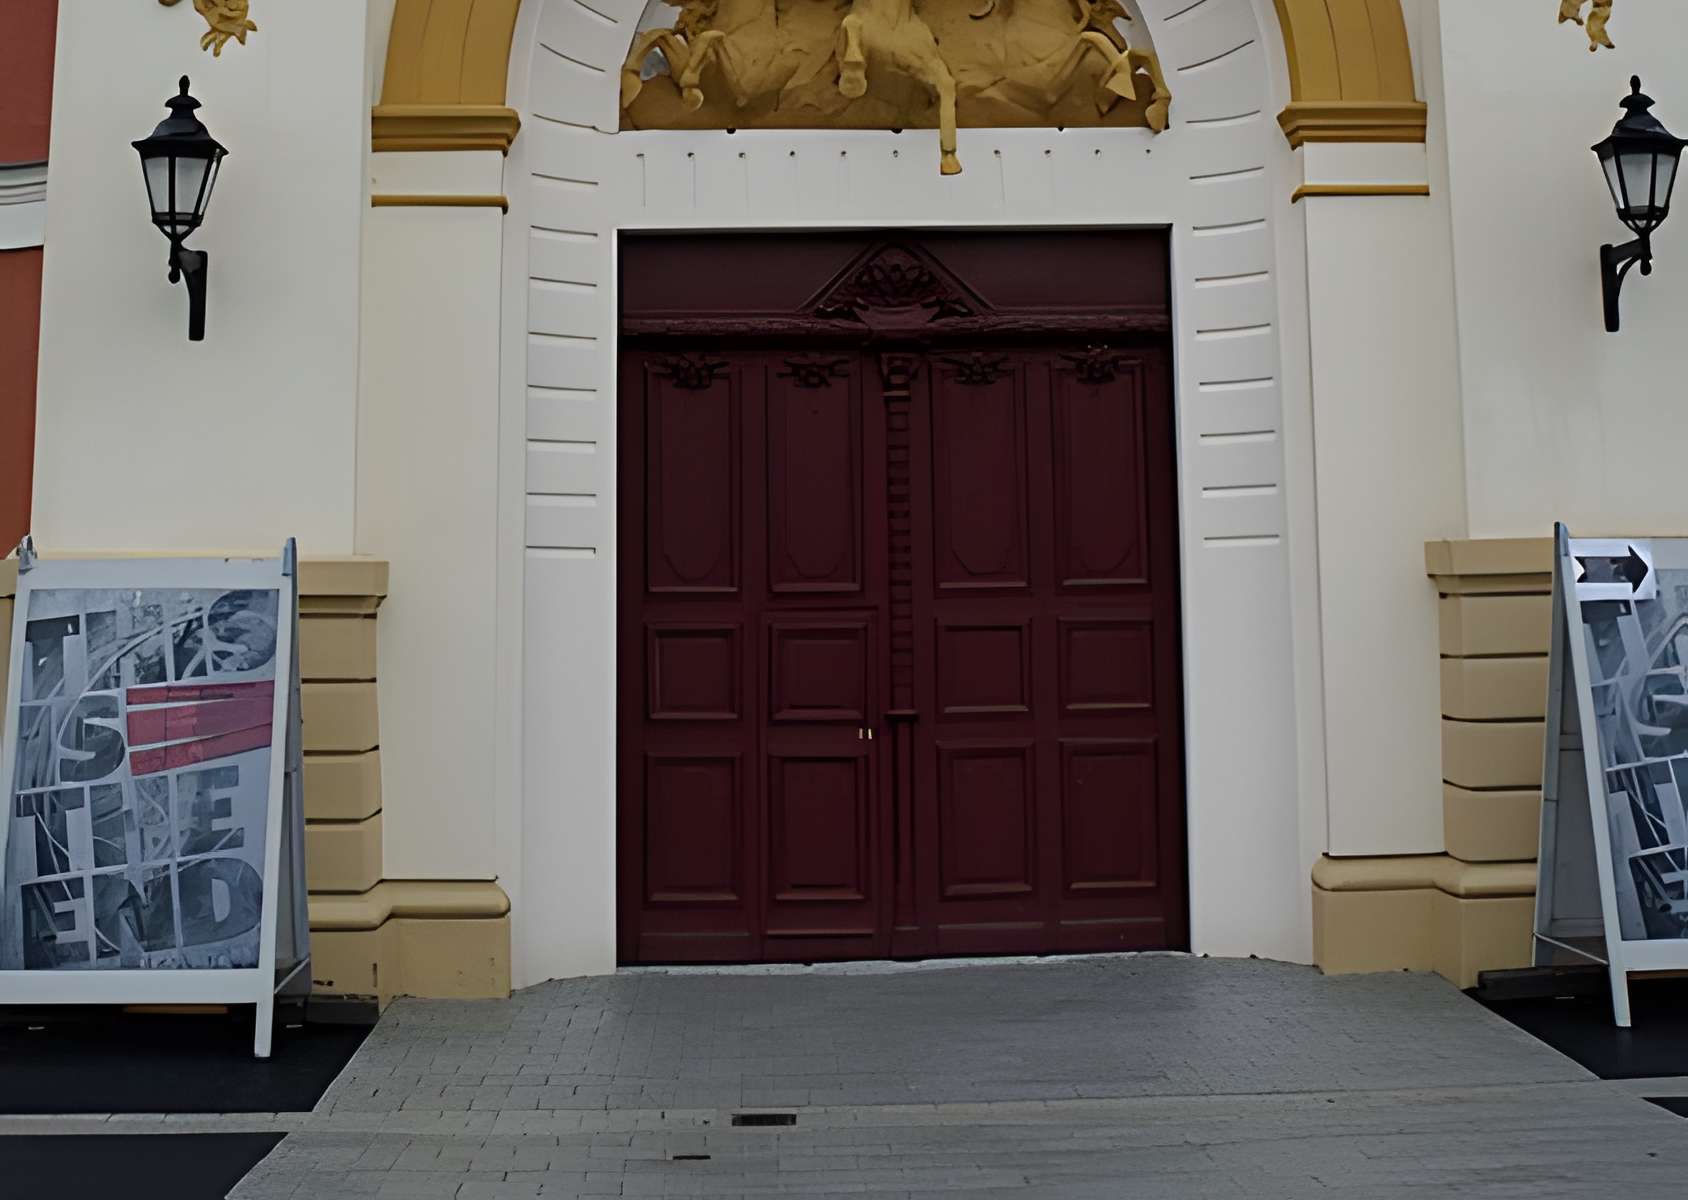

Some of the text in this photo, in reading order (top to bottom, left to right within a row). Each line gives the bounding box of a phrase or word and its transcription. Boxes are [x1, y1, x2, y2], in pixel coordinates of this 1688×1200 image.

[24, 590, 277, 702] THIS
[15, 765, 245, 875] THE
[20, 857, 262, 969] END
